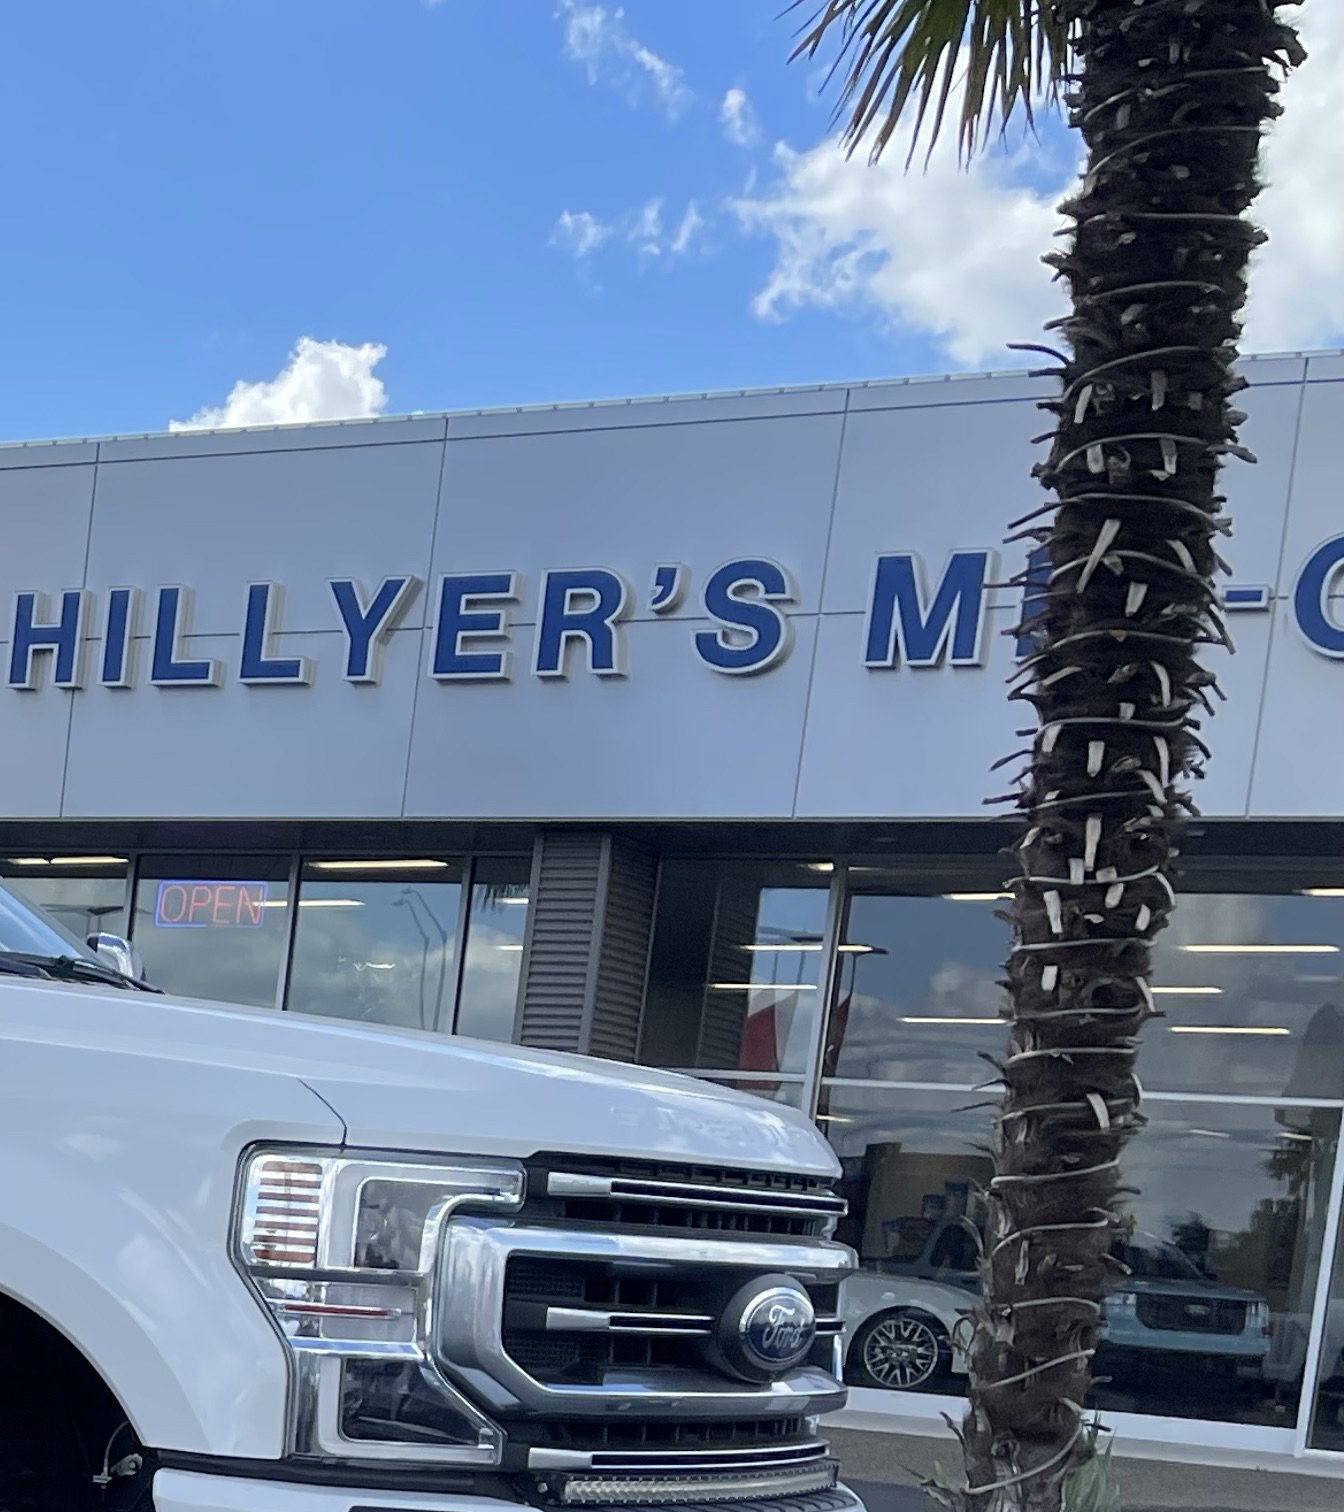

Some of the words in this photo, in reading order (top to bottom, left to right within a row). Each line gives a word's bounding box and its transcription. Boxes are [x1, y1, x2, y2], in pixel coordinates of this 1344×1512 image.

[8, 556, 796, 689] HILLYER'S
[160, 885, 264, 924] OPEN
[762, 1304, 806, 1349] Ford
